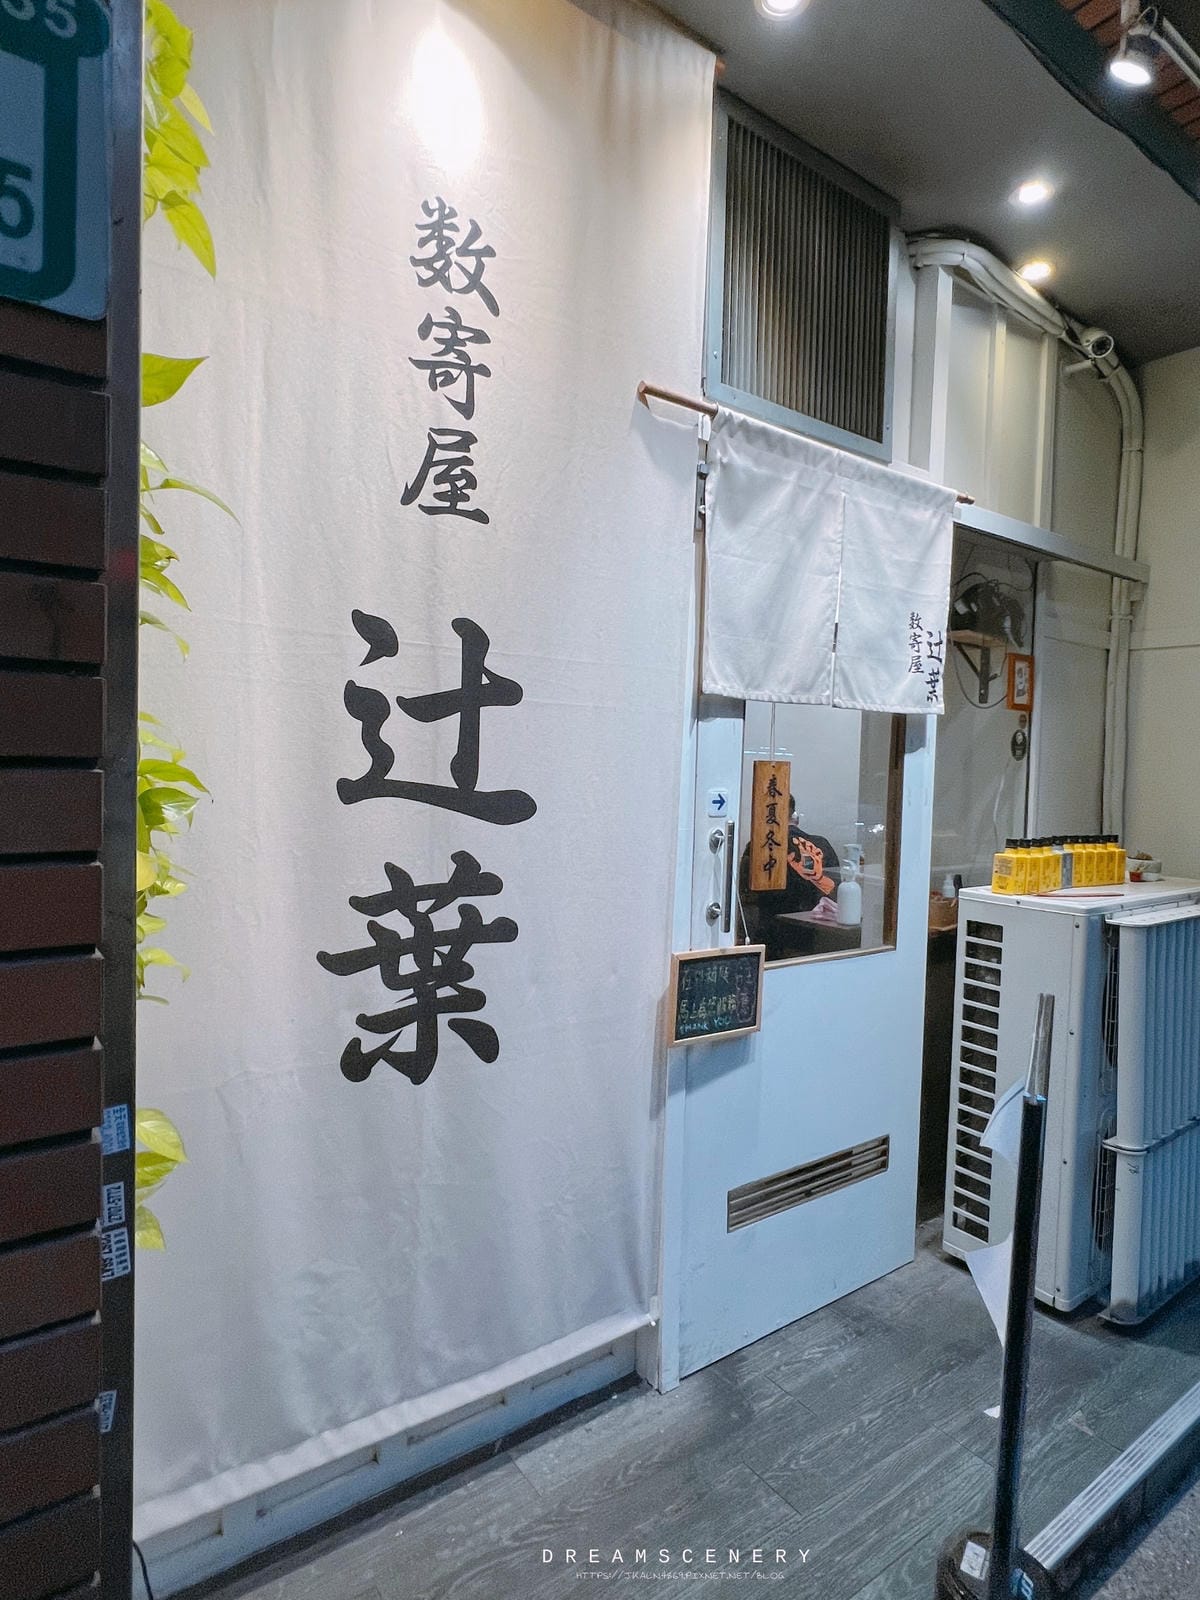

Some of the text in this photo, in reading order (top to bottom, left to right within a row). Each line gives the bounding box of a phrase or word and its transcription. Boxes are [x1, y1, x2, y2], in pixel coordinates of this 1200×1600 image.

[317, 610, 537, 1085] 辻葉
[760, 774, 783, 881] 春夏冬中
